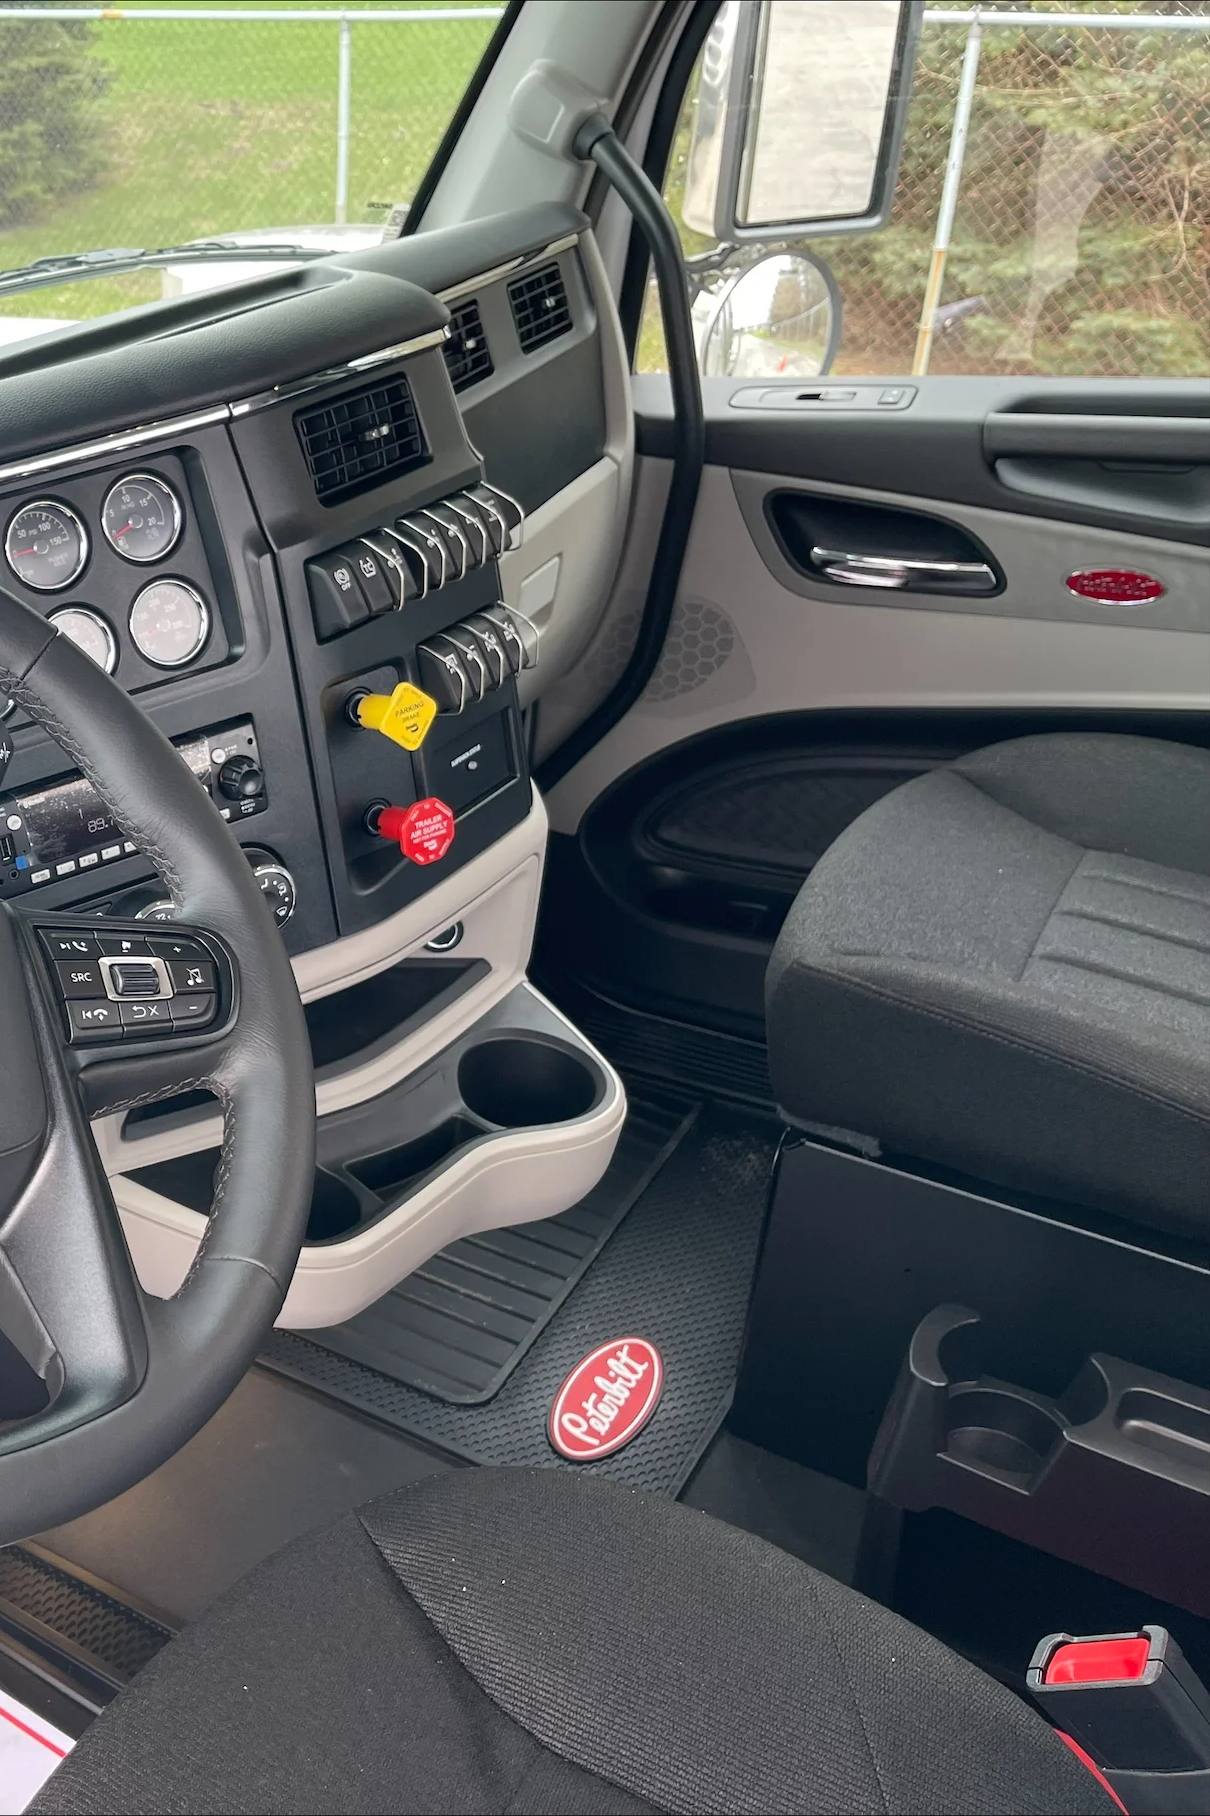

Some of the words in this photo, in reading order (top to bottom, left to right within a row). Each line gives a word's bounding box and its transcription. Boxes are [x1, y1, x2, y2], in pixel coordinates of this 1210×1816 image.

[394, 701, 424, 718] PARKING
[411, 829, 422, 840] AIR
[422, 820, 448, 835] SUPPLY
[415, 814, 443, 830] TRAILER
[71, 972, 93, 983] SRC
[561, 1344, 649, 1446] Peterbilt
